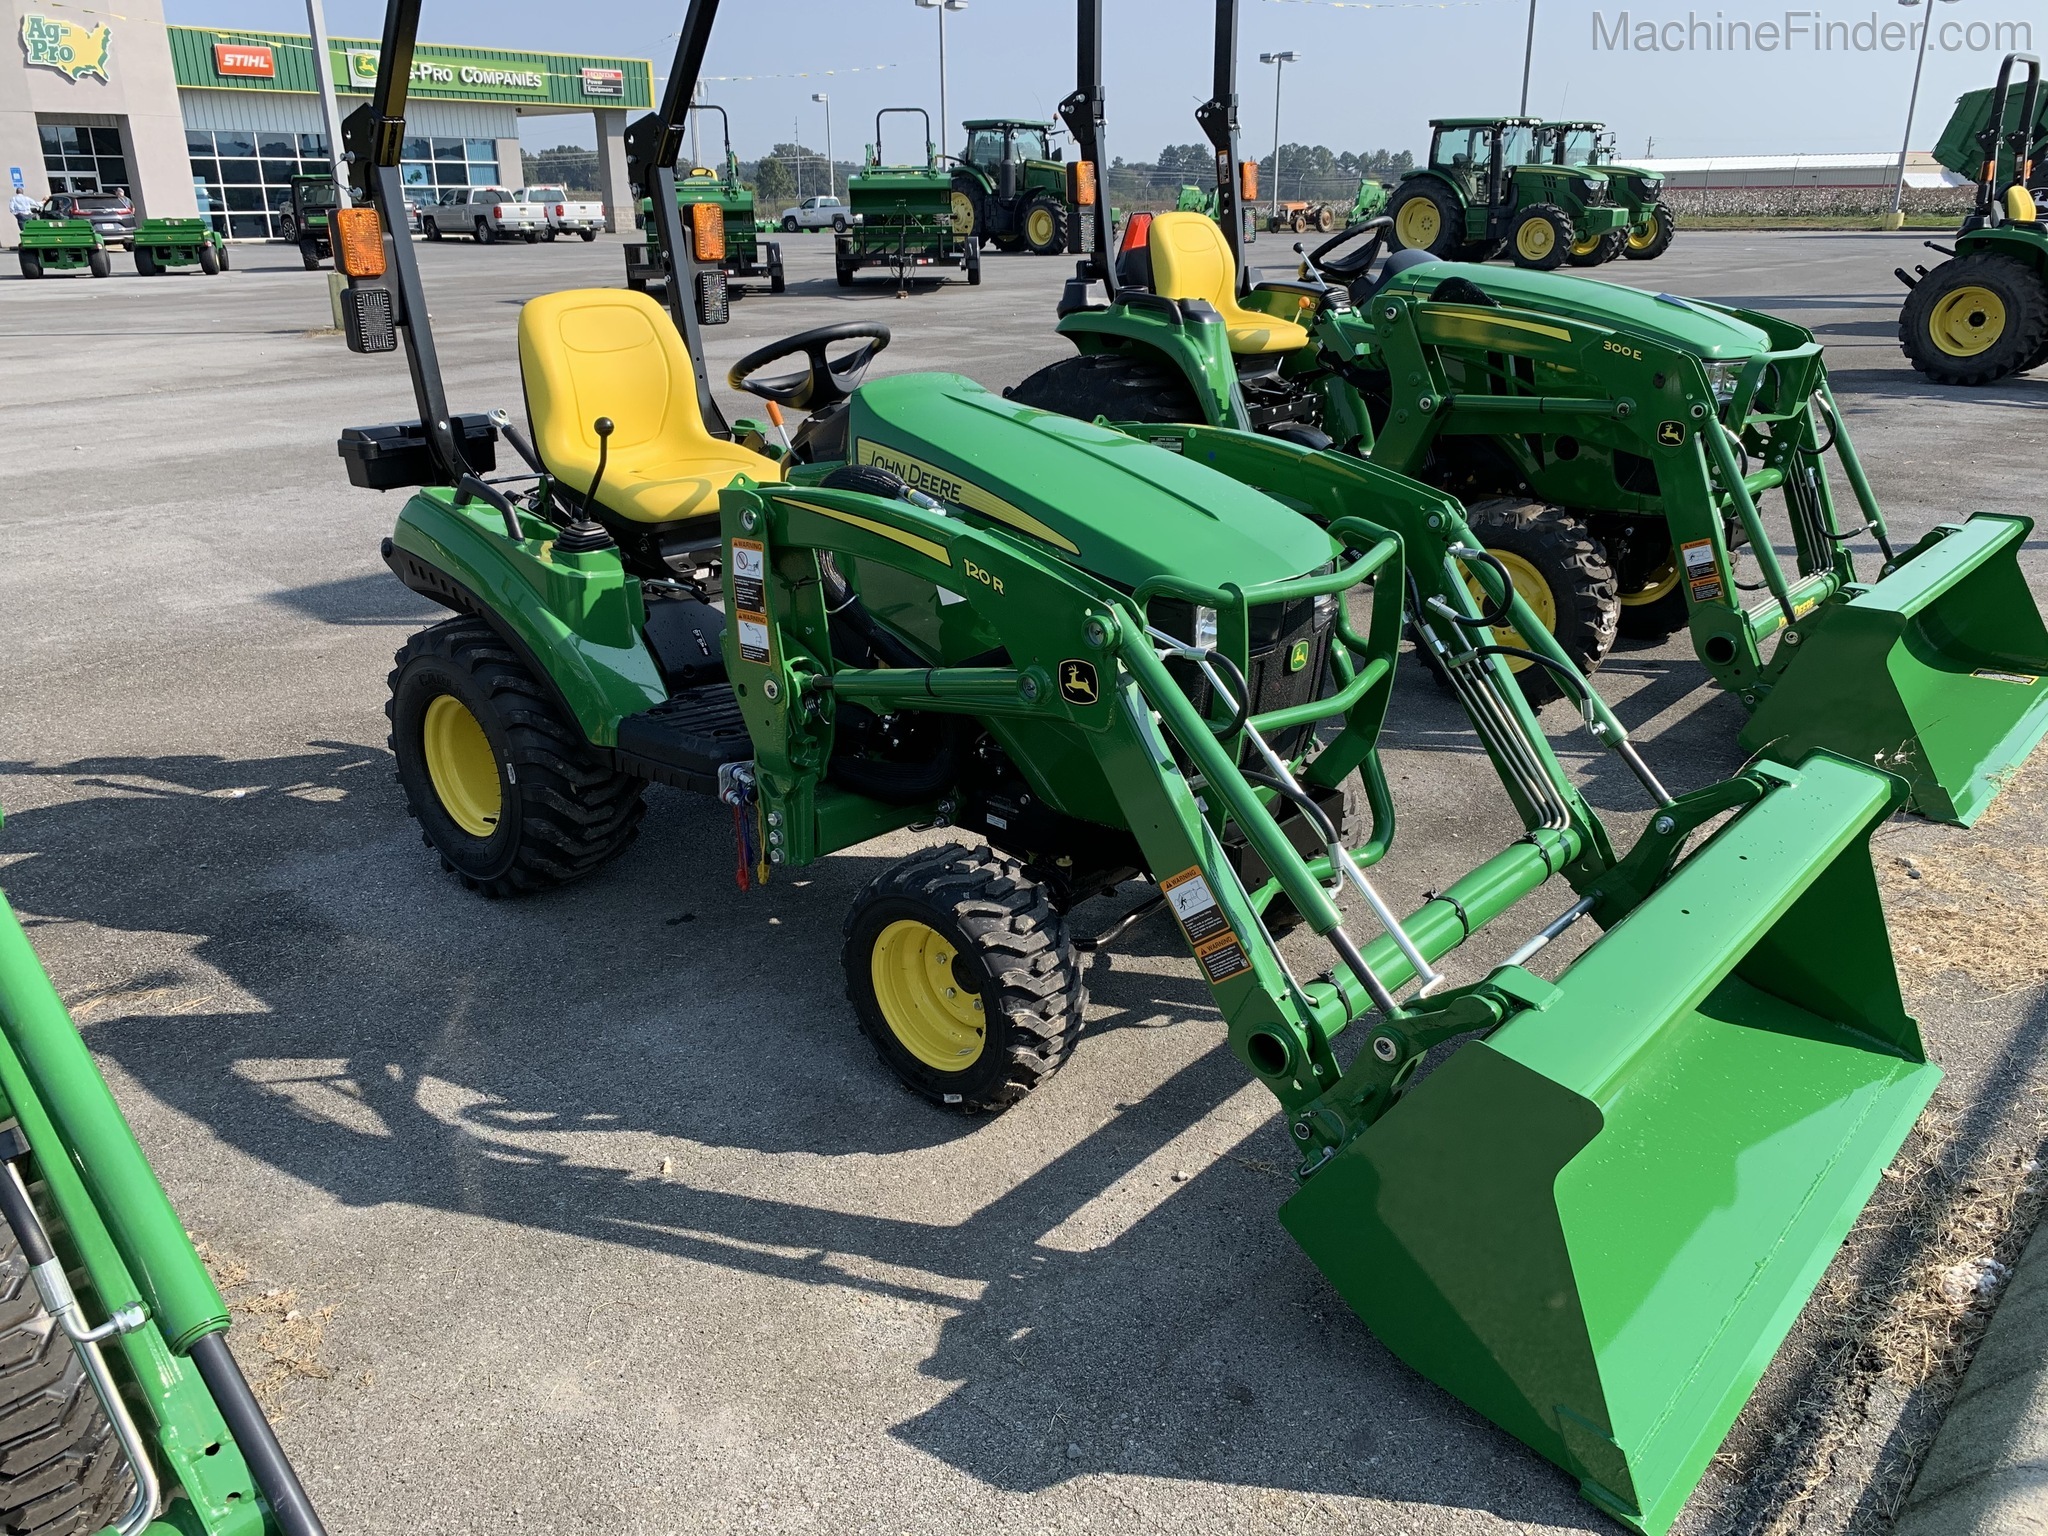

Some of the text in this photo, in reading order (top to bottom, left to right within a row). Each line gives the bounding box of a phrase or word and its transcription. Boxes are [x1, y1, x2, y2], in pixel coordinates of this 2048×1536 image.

[28, 16, 70, 44] Ag-
[31, 40, 74, 62] Pro
[223, 54, 269, 68] STIHL
[461, 66, 543, 87] COMPANIES
[586, 71, 615, 79] HONDA
[908, 463, 962, 502] DEERE
[738, 540, 762, 550] WARNING
[1794, 597, 1816, 616] DEERE
[743, 614, 766, 623] WARNING
[1172, 869, 1197, 886] WARNING
[1206, 936, 1233, 952] WARNING
